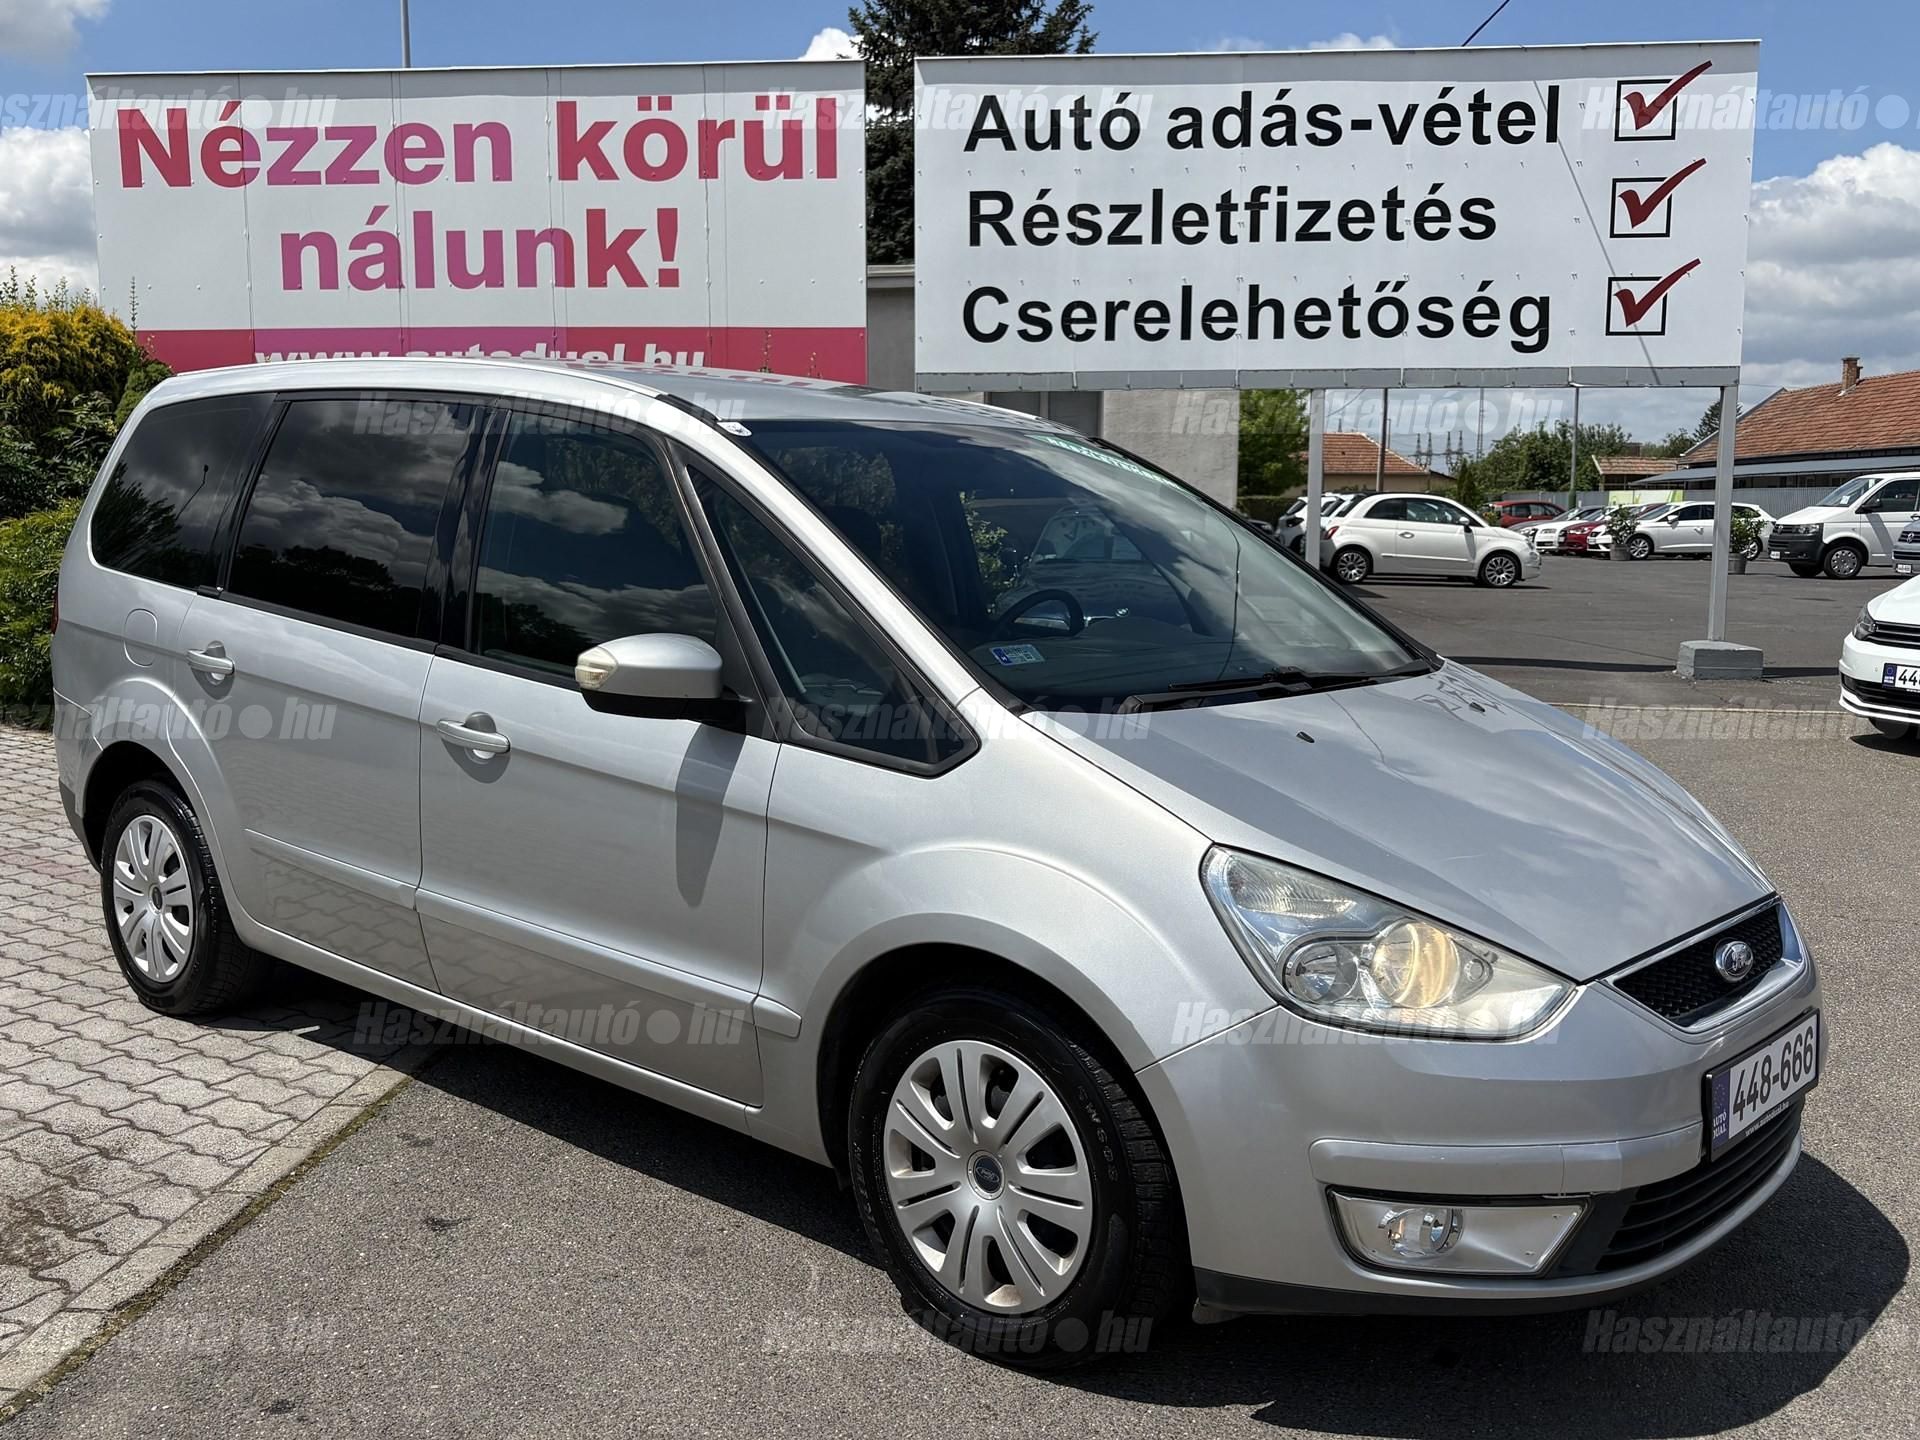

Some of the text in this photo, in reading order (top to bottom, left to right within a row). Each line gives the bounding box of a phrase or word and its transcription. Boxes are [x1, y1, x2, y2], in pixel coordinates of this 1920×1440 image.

[117, 96, 838, 188] Nézzen körül
[964, 84, 1560, 152] Autó adás-vétel
[281, 205, 680, 291] nálunk!
[968, 184, 1497, 248] Részletfizetés
[963, 280, 1551, 353] Cserelehetőség
[1898, 669, 1920, 686] 44
[1733, 1026, 1813, 1122] 448-666
